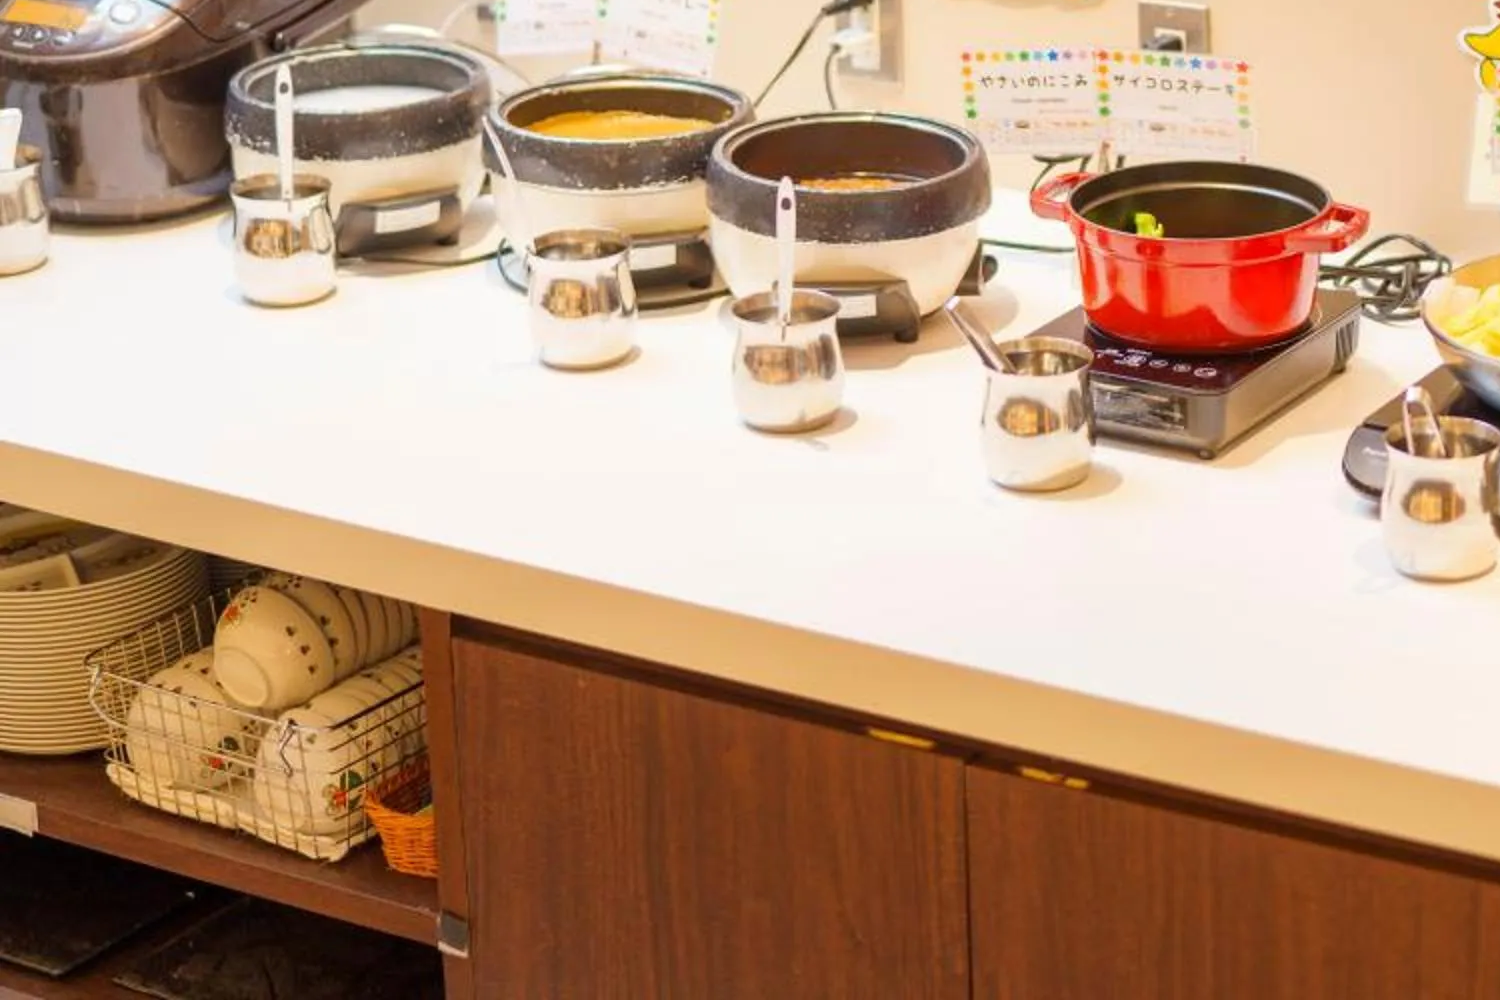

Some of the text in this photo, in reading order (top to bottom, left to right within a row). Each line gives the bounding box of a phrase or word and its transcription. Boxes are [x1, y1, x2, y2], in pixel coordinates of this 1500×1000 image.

[977, 74, 1088, 90] やさいのにこみ
